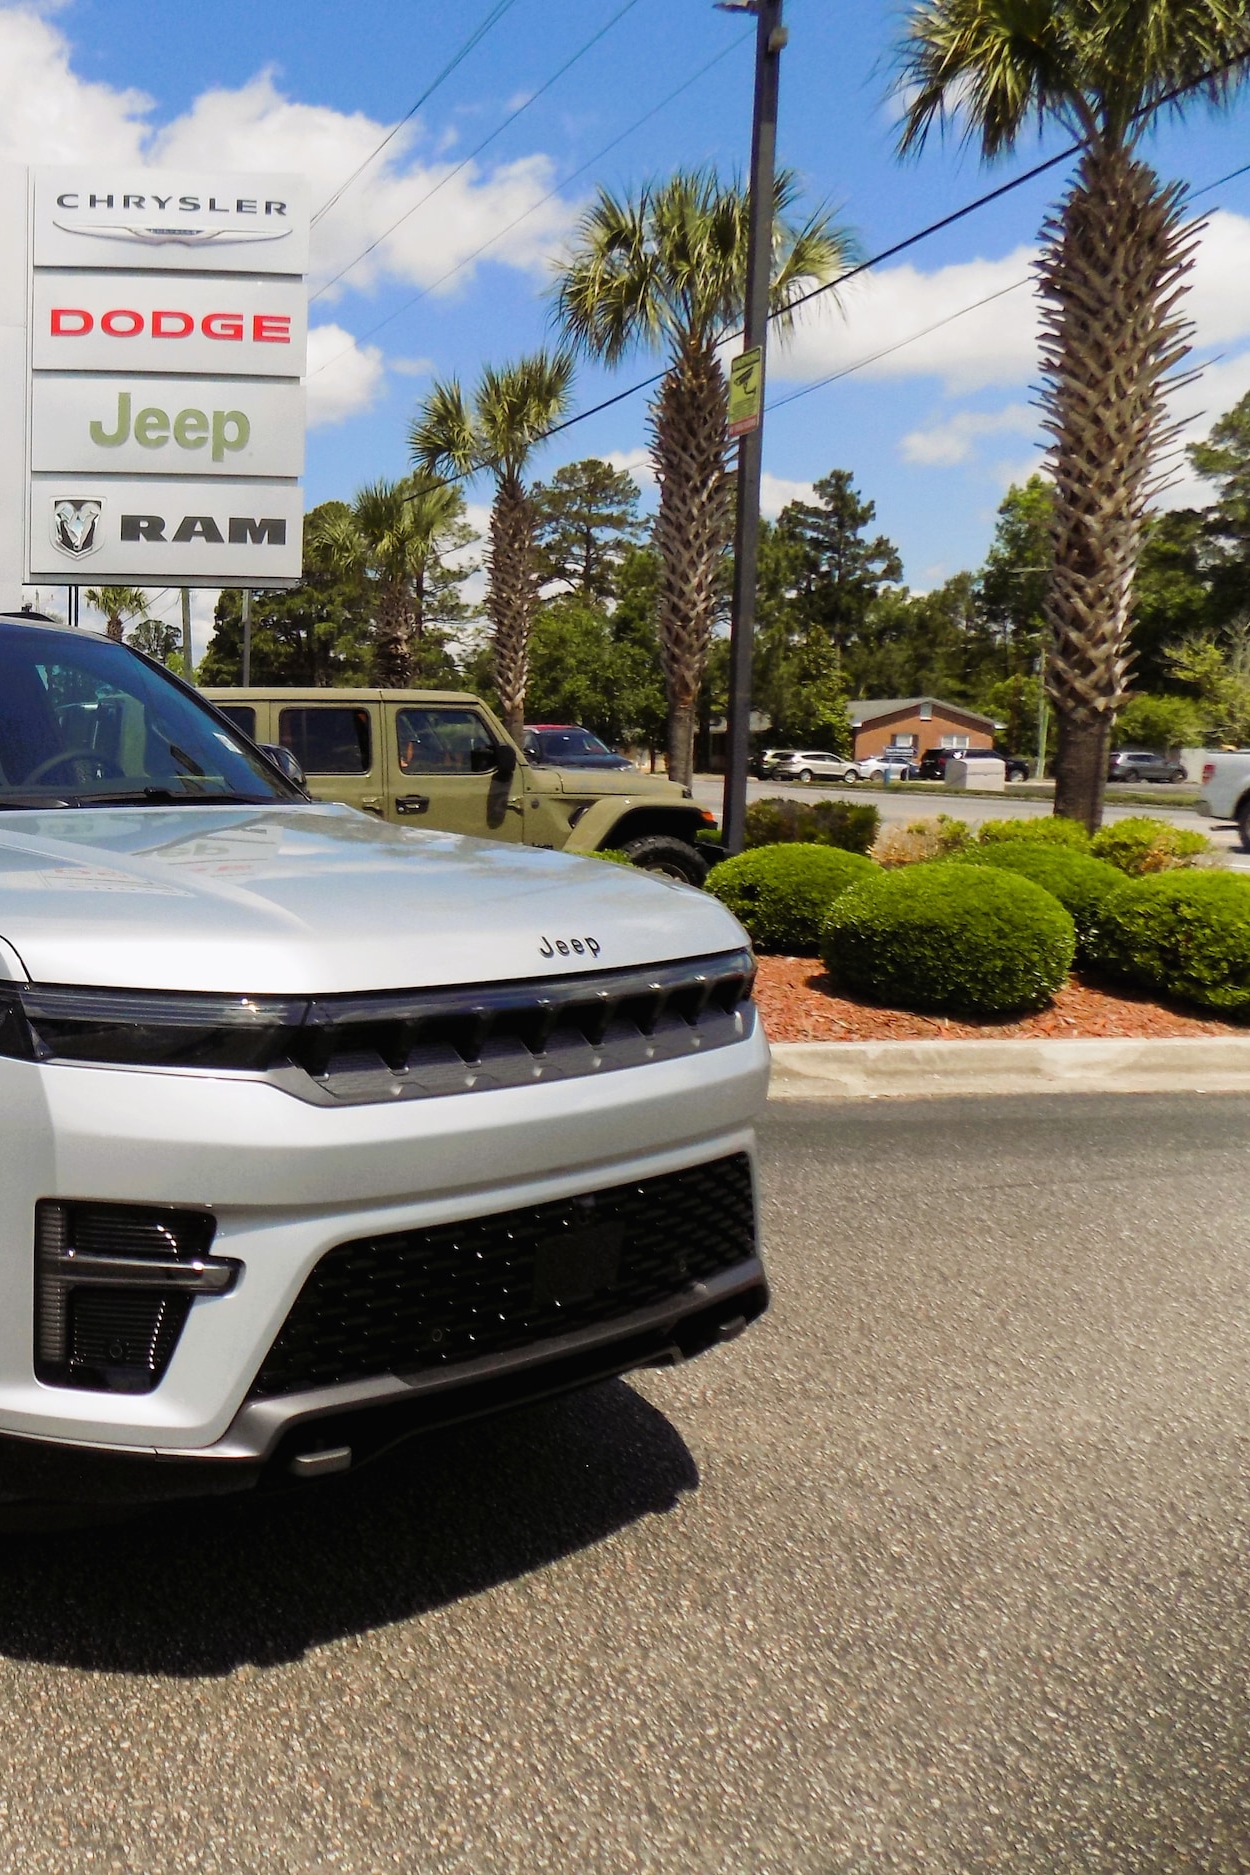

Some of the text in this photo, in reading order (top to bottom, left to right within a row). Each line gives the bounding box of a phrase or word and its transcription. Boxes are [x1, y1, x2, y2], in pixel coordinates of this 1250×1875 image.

[56, 193, 288, 216] CHRYSLER
[50, 308, 292, 344] DODGE
[89, 391, 251, 462] Jeep
[120, 514, 287, 546] RAM
[539, 935, 601, 959] Jeep
